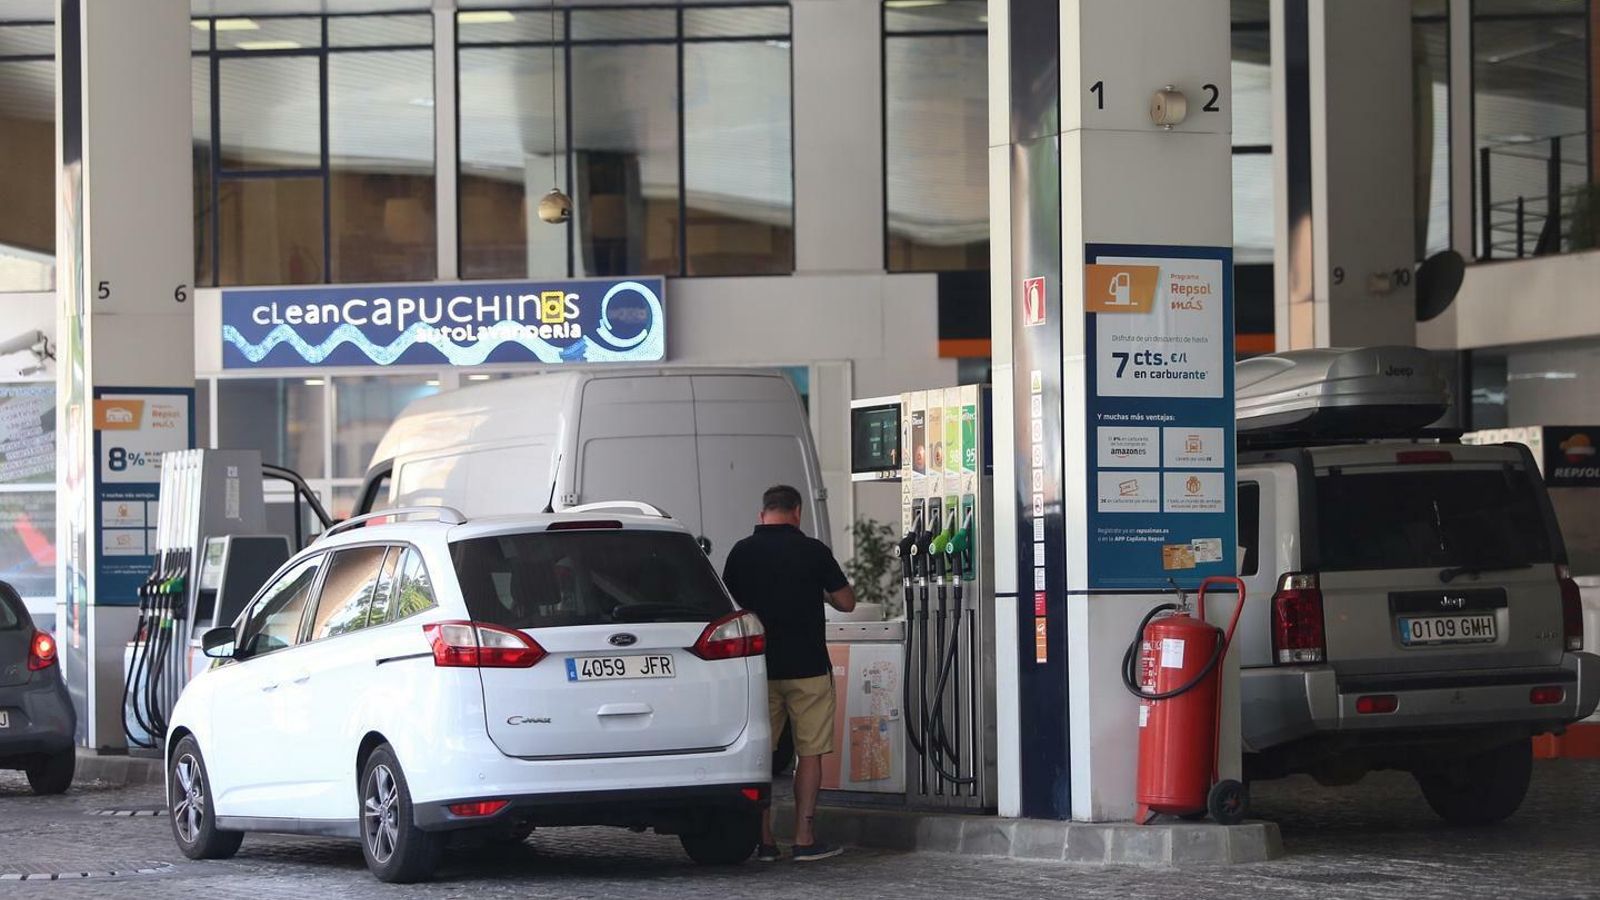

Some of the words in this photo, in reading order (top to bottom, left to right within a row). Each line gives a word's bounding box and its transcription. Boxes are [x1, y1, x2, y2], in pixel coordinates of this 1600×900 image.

[1090, 81, 1103, 109] 1
[1202, 84, 1219, 112] 2
[1333, 266, 1345, 285] 9
[1393, 269, 1410, 286] 10
[98, 281, 110, 299] 5
[174, 285, 187, 302] 6
[1170, 283, 1211, 296] Repsol
[1171, 297, 1203, 310] más
[1112, 352, 1129, 378] 7
[1134, 350, 1168, 365] cts.
[1385, 364, 1414, 377] Jeep
[1134, 370, 1147, 379] en
[1103, 413, 1129, 421] muchas
[1554, 467, 1600, 478] REPSOL
[1440, 595, 1466, 608] Jeep
[1412, 618, 1456, 640] 0109
[1460, 617, 1493, 637] GMH
[581, 657, 626, 678] 4059
[640, 656, 672, 676] JFR
